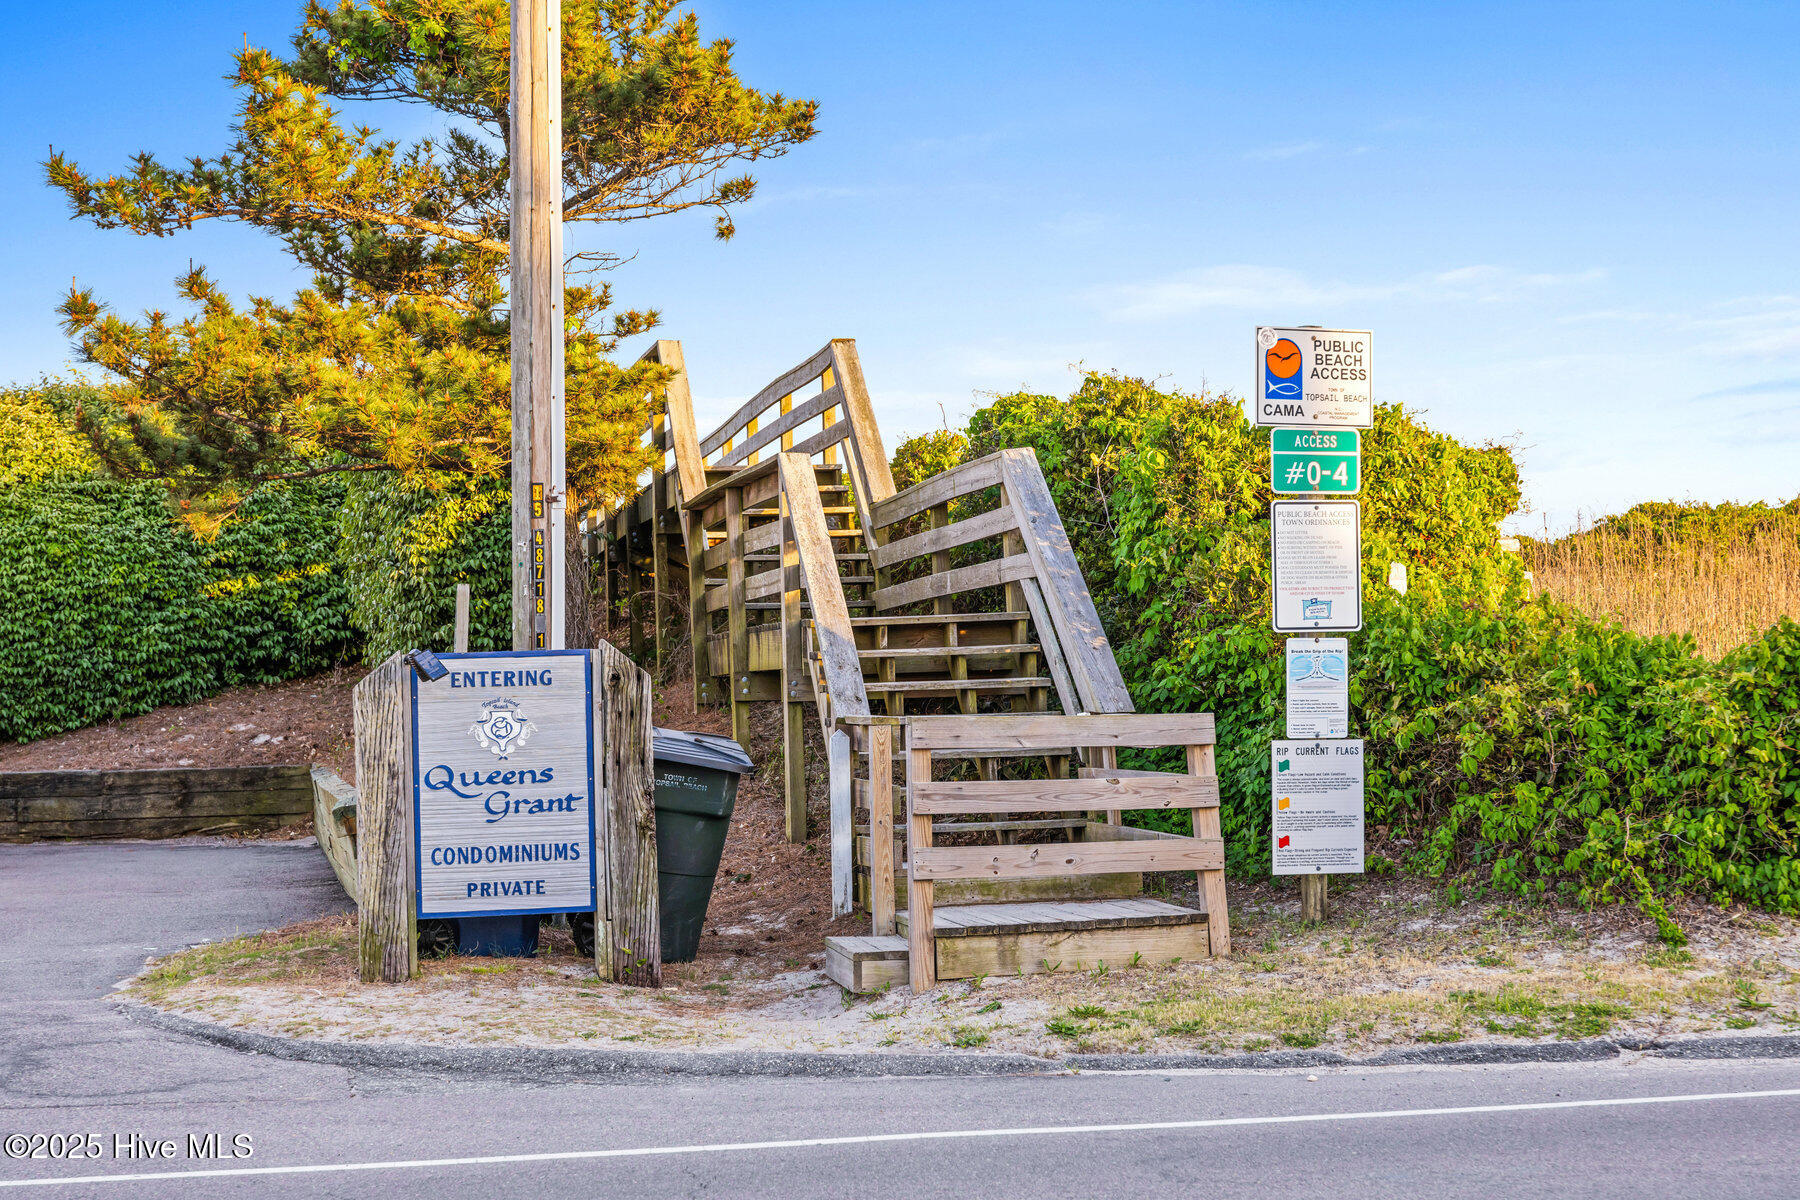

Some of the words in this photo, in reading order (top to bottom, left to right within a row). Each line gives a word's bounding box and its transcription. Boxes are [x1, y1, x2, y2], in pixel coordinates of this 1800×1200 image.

[1313, 340, 1363, 353] PUBLIC
[1315, 354, 1362, 367] BEACH
[1310, 367, 1366, 380] ACCESS
[1306, 393, 1339, 402] TOPSAIL
[1344, 394, 1367, 402] BEACH
[1264, 404, 1304, 416] CAMA
[1294, 435, 1338, 448] ACCESS
[1284, 461, 1348, 486] #0-4
[1277, 510, 1302, 518] PUBLIC
[1304, 510, 1327, 518] BEACH
[1328, 510, 1354, 518] ACCESS
[1281, 518, 1304, 526] TOWN
[1304, 518, 1350, 526] ORDINANCES
[451, 670, 553, 688] ENTERING
[1276, 747, 1288, 756] RIP
[1296, 747, 1330, 756] CURRENT
[1336, 747, 1359, 755] FLAGS
[424, 764, 554, 798] Queens
[484, 790, 584, 823] Grant
[431, 843, 580, 866] CONDOMINIUMS
[467, 880, 546, 898] PRIVATE
